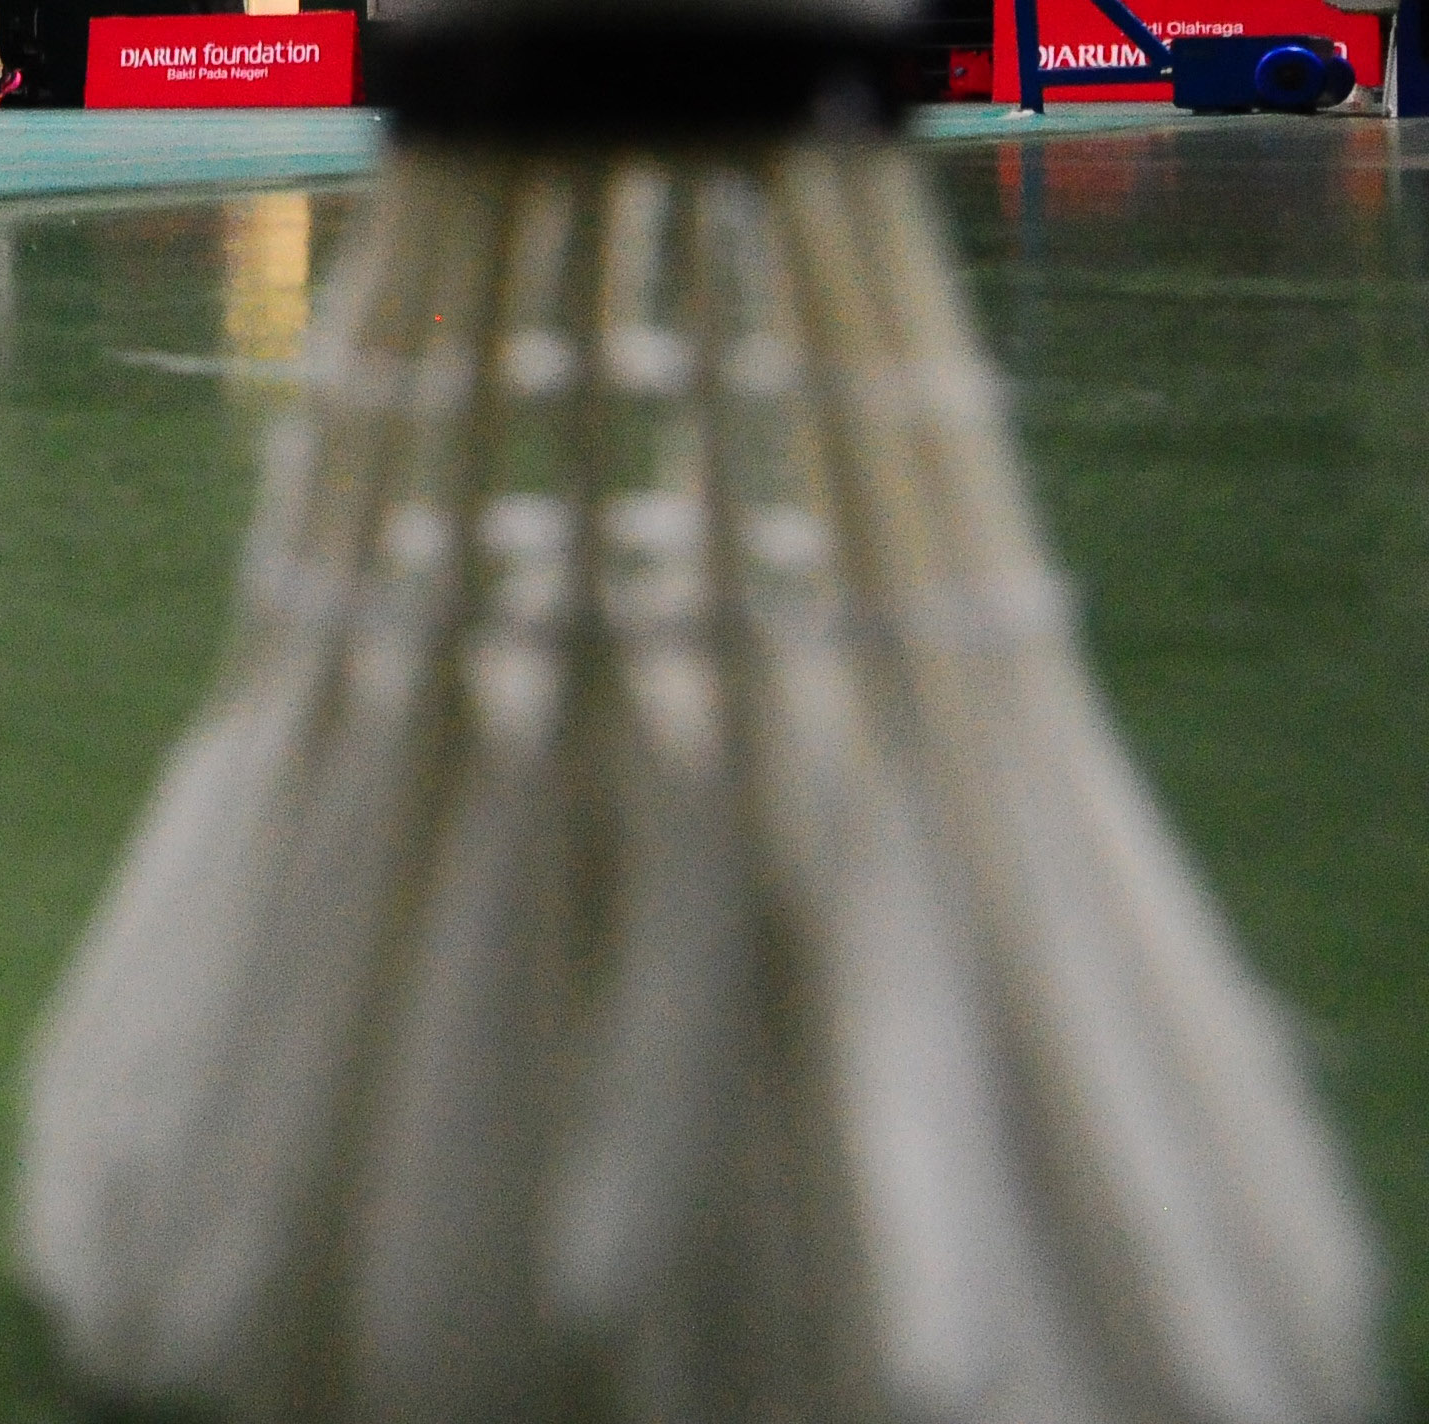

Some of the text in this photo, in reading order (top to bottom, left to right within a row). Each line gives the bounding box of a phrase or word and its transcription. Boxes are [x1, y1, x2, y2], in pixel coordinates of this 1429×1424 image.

[1167, 21, 1244, 37] Olahraga
[121, 40, 320, 69] DJARUM foundation
[167, 66, 269, 82] Bakti Pada Negeri
